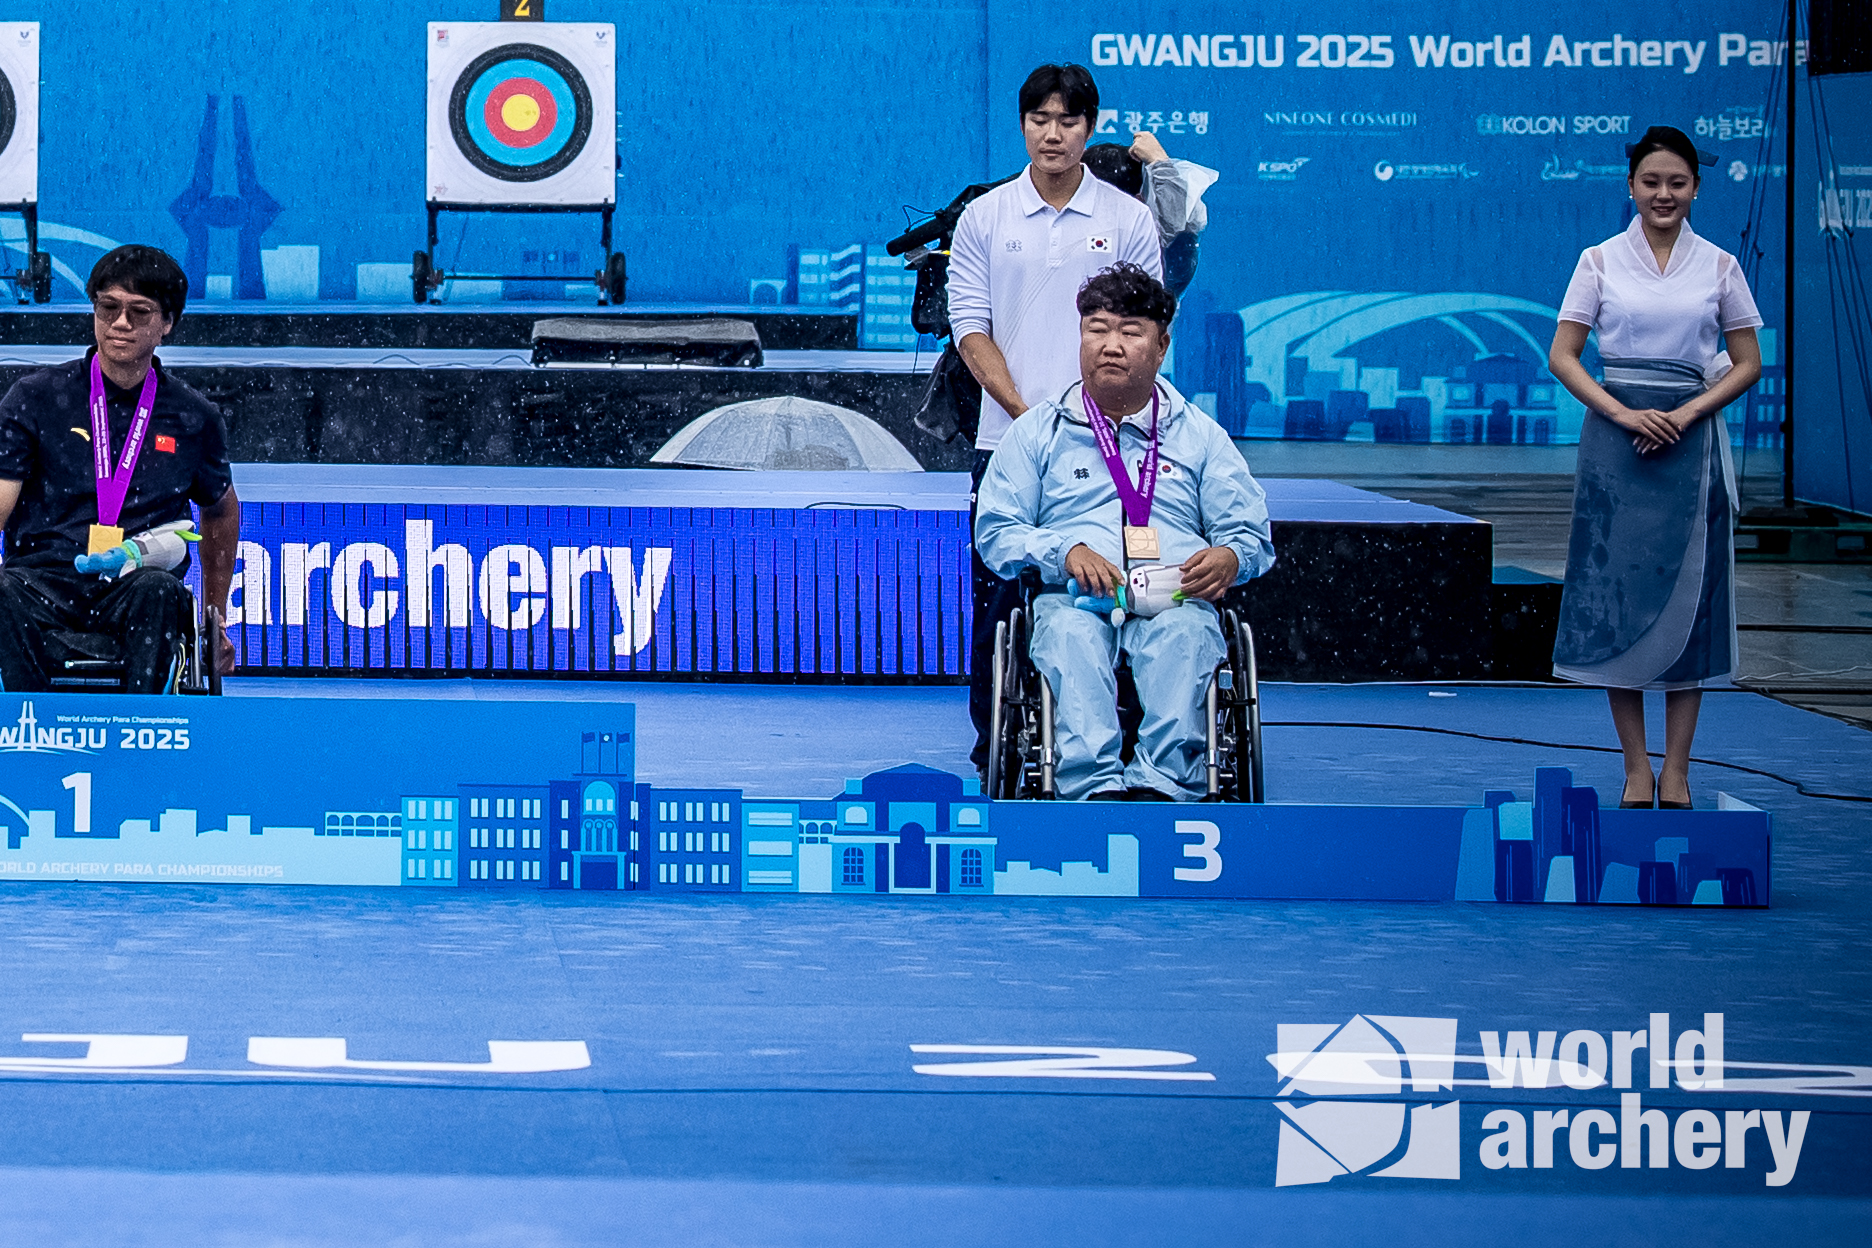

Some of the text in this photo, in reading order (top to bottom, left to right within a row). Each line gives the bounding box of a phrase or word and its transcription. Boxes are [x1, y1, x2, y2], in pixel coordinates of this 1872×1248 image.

[1091, 33, 1285, 68] GWANGJU
[1295, 34, 1395, 68] 2025
[1409, 34, 1532, 68] World
[1544, 33, 1707, 74] Archery
[1123, 109, 1210, 135] 광주은행
[1501, 115, 1631, 135] KOLON SPORT
[227, 519, 672, 656] archery
[57, 714, 79, 723] World
[81, 715, 112, 725] Archery
[113, 715, 130, 724] Para
[120, 728, 191, 750] 2025
[61, 772, 92, 833] 1
[1173, 820, 1223, 882] 3
[41, 862, 109, 876] ARCHERY
[114, 863, 154, 876] PARA
[158, 864, 284, 878] CHAMPIONSHIPS
